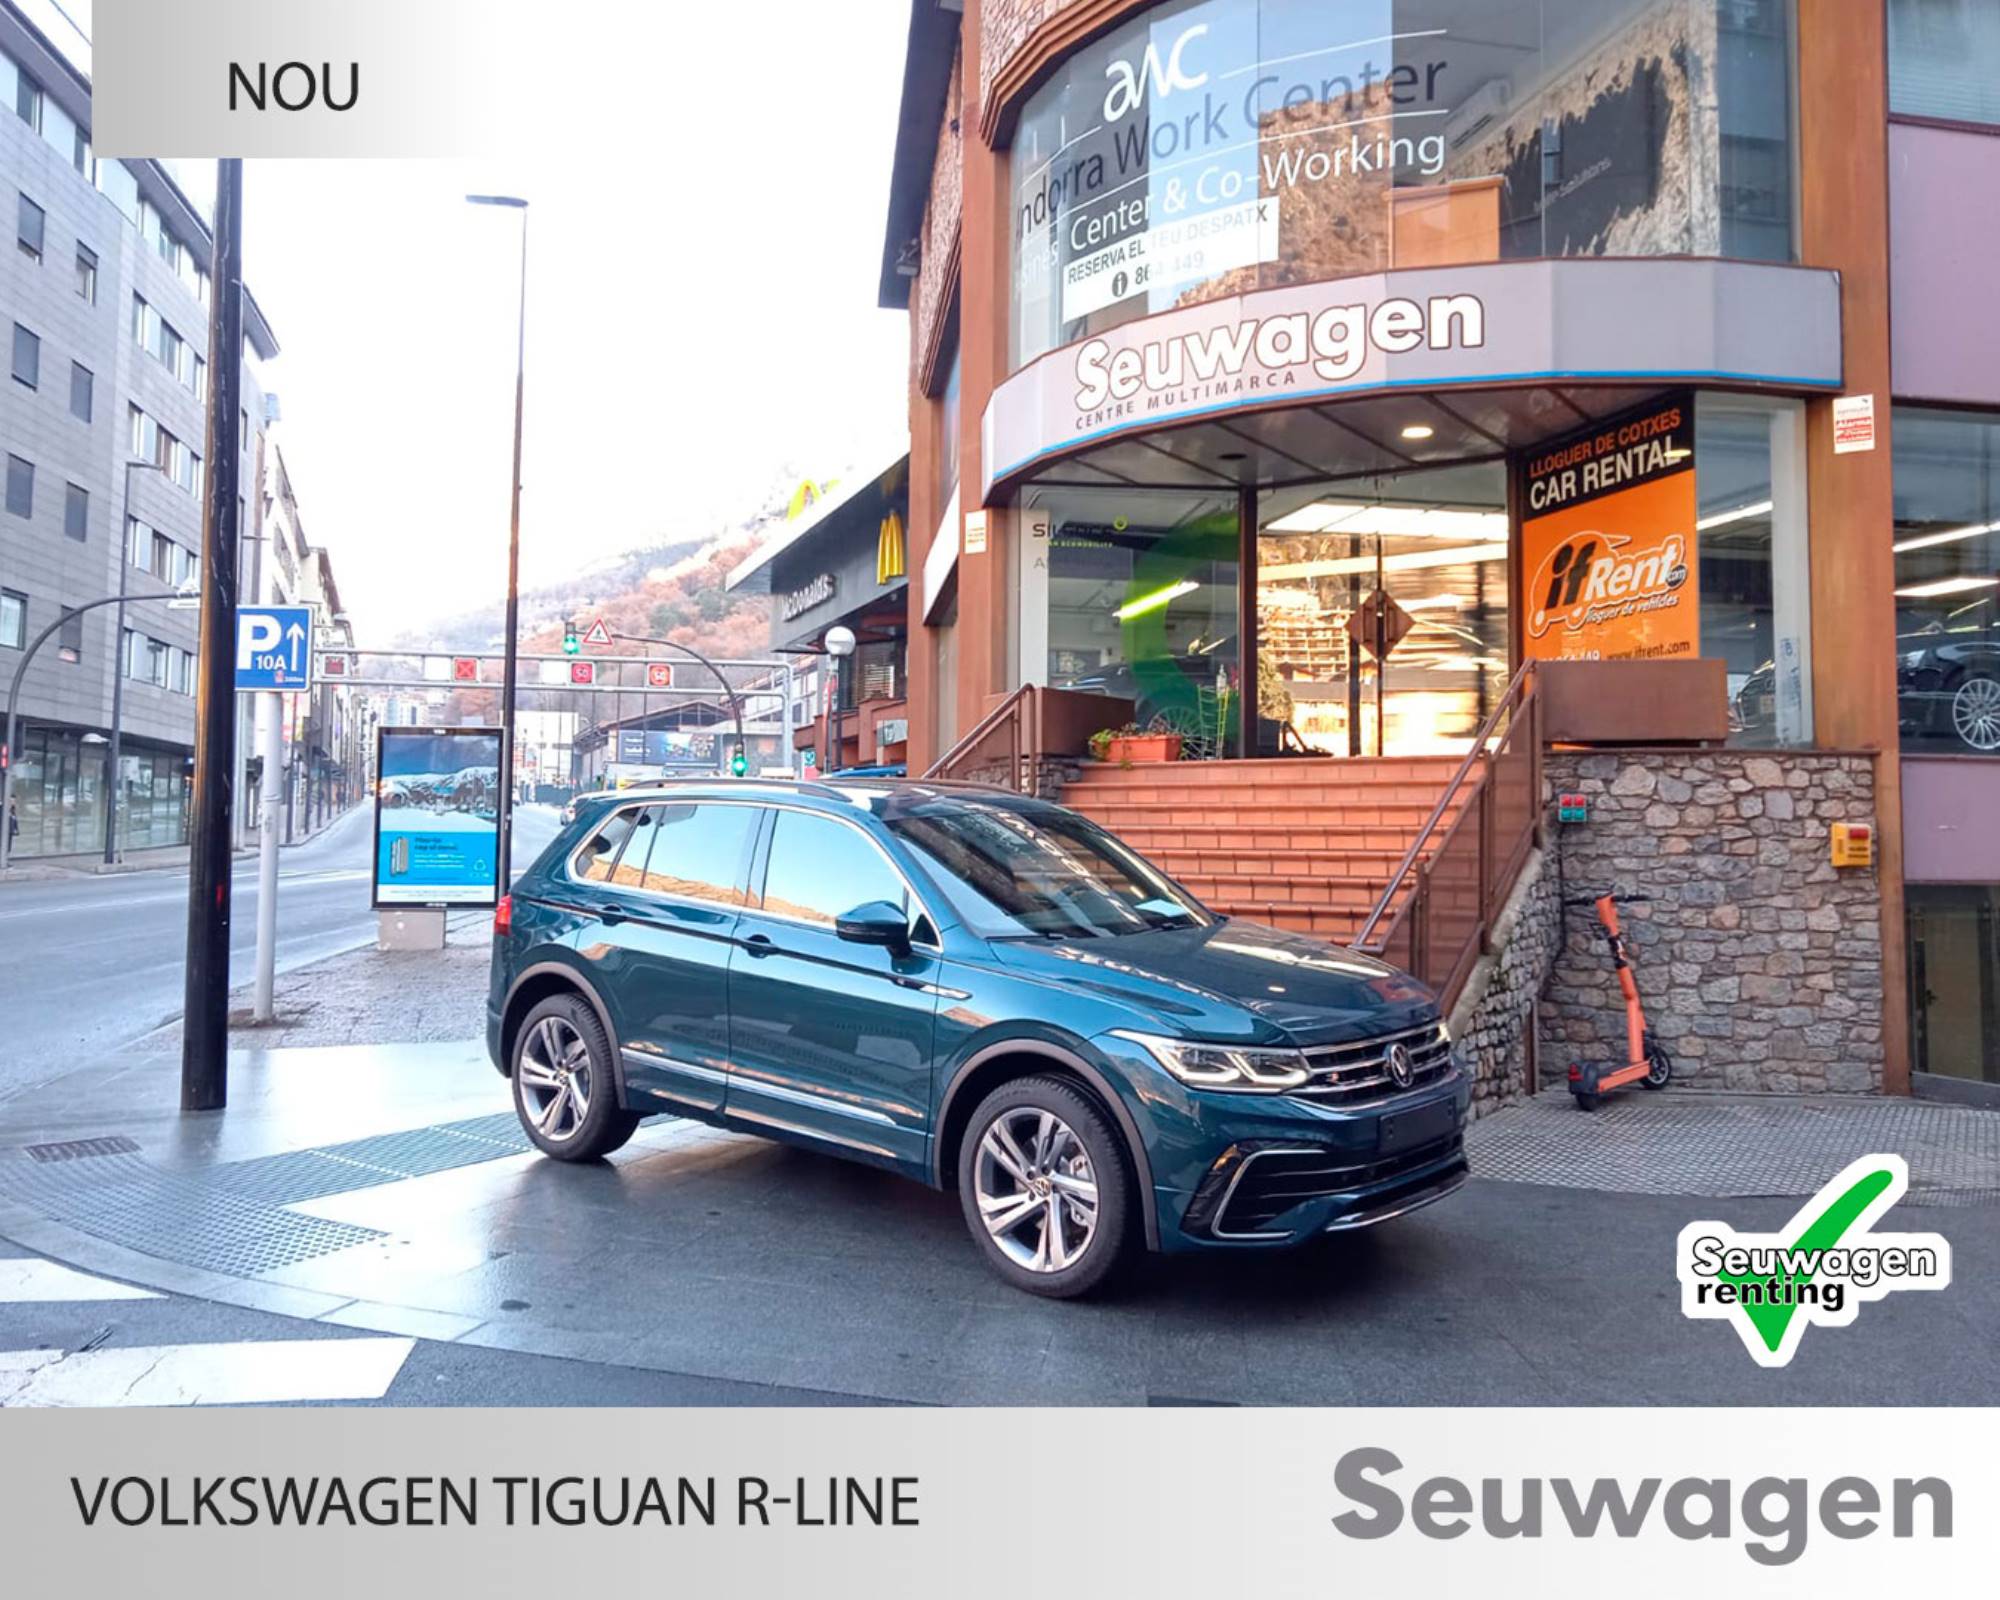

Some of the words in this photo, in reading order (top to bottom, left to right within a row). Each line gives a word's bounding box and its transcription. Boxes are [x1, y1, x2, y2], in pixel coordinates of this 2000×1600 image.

[1020, 153, 1103, 239] ndorra
[1114, 93, 1229, 175] Work
[1244, 61, 1446, 129] Center
[1071, 194, 1153, 250] Center
[1163, 178, 1187, 212] &
[1196, 133, 1446, 202] Co-Working
[1068, 247, 1126, 284] RESERVA
[1129, 239, 1146, 259] EL
[1151, 227, 1181, 248] TEU
[1188, 204, 1268, 240] DESPATX
[1074, 294, 1484, 412] Seuwagen
[1075, 399, 1135, 430] CENTRE
[1147, 373, 1297, 410] MULTIMARCA
[1530, 441, 1592, 478] LLOGUER
[1595, 432, 1615, 454] DE
[1618, 408, 1681, 445] COTXES
[1530, 469, 1577, 510] CAR
[1583, 434, 1682, 494] RENTAL
[237, 614, 282, 670] P
[255, 654, 287, 670] 10A
